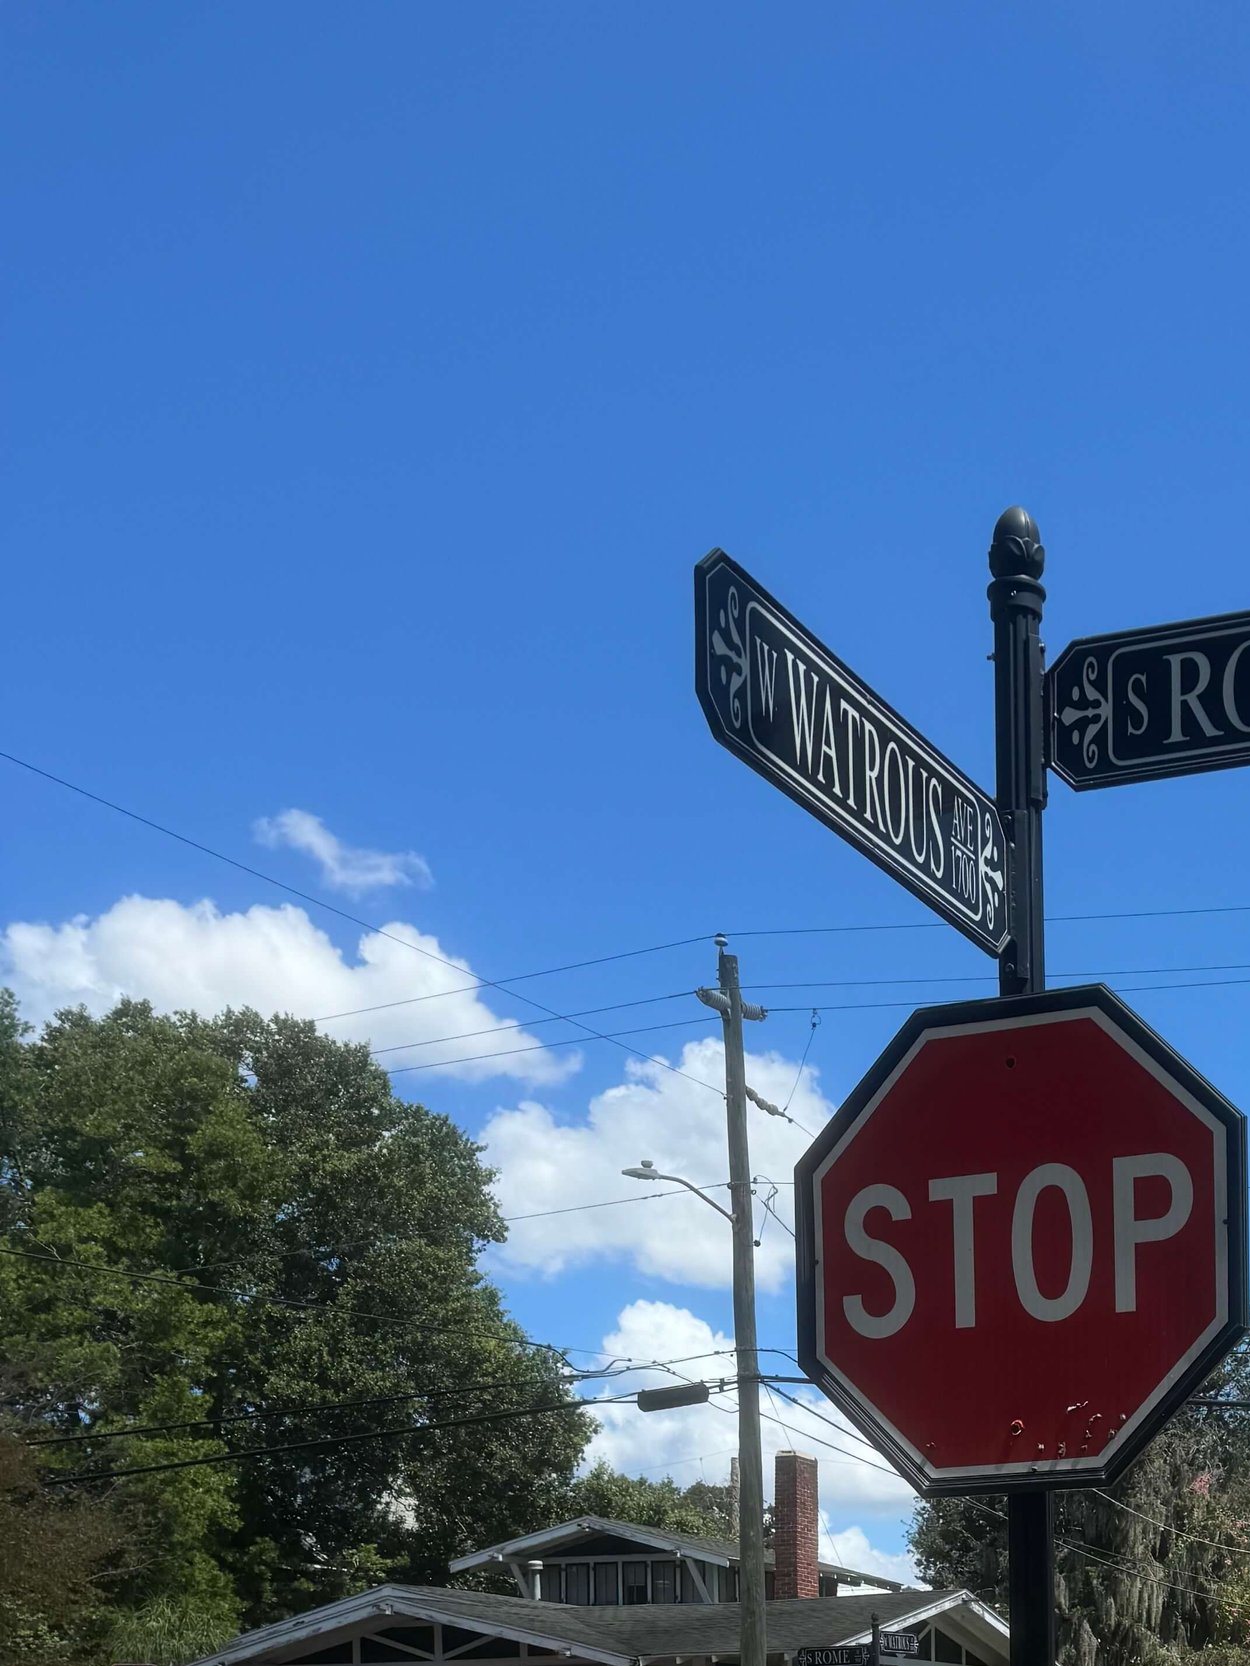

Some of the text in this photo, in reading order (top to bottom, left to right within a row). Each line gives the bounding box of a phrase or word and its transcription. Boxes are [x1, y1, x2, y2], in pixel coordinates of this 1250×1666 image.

[1127, 671, 1149, 737] S
[754, 635, 944, 880] W WATROUS
[951, 795, 975, 852] AVE
[951, 845, 976, 904] 1700
[842, 1152, 1194, 1340] STOP
[815, 1649, 851, 1665] ROME
